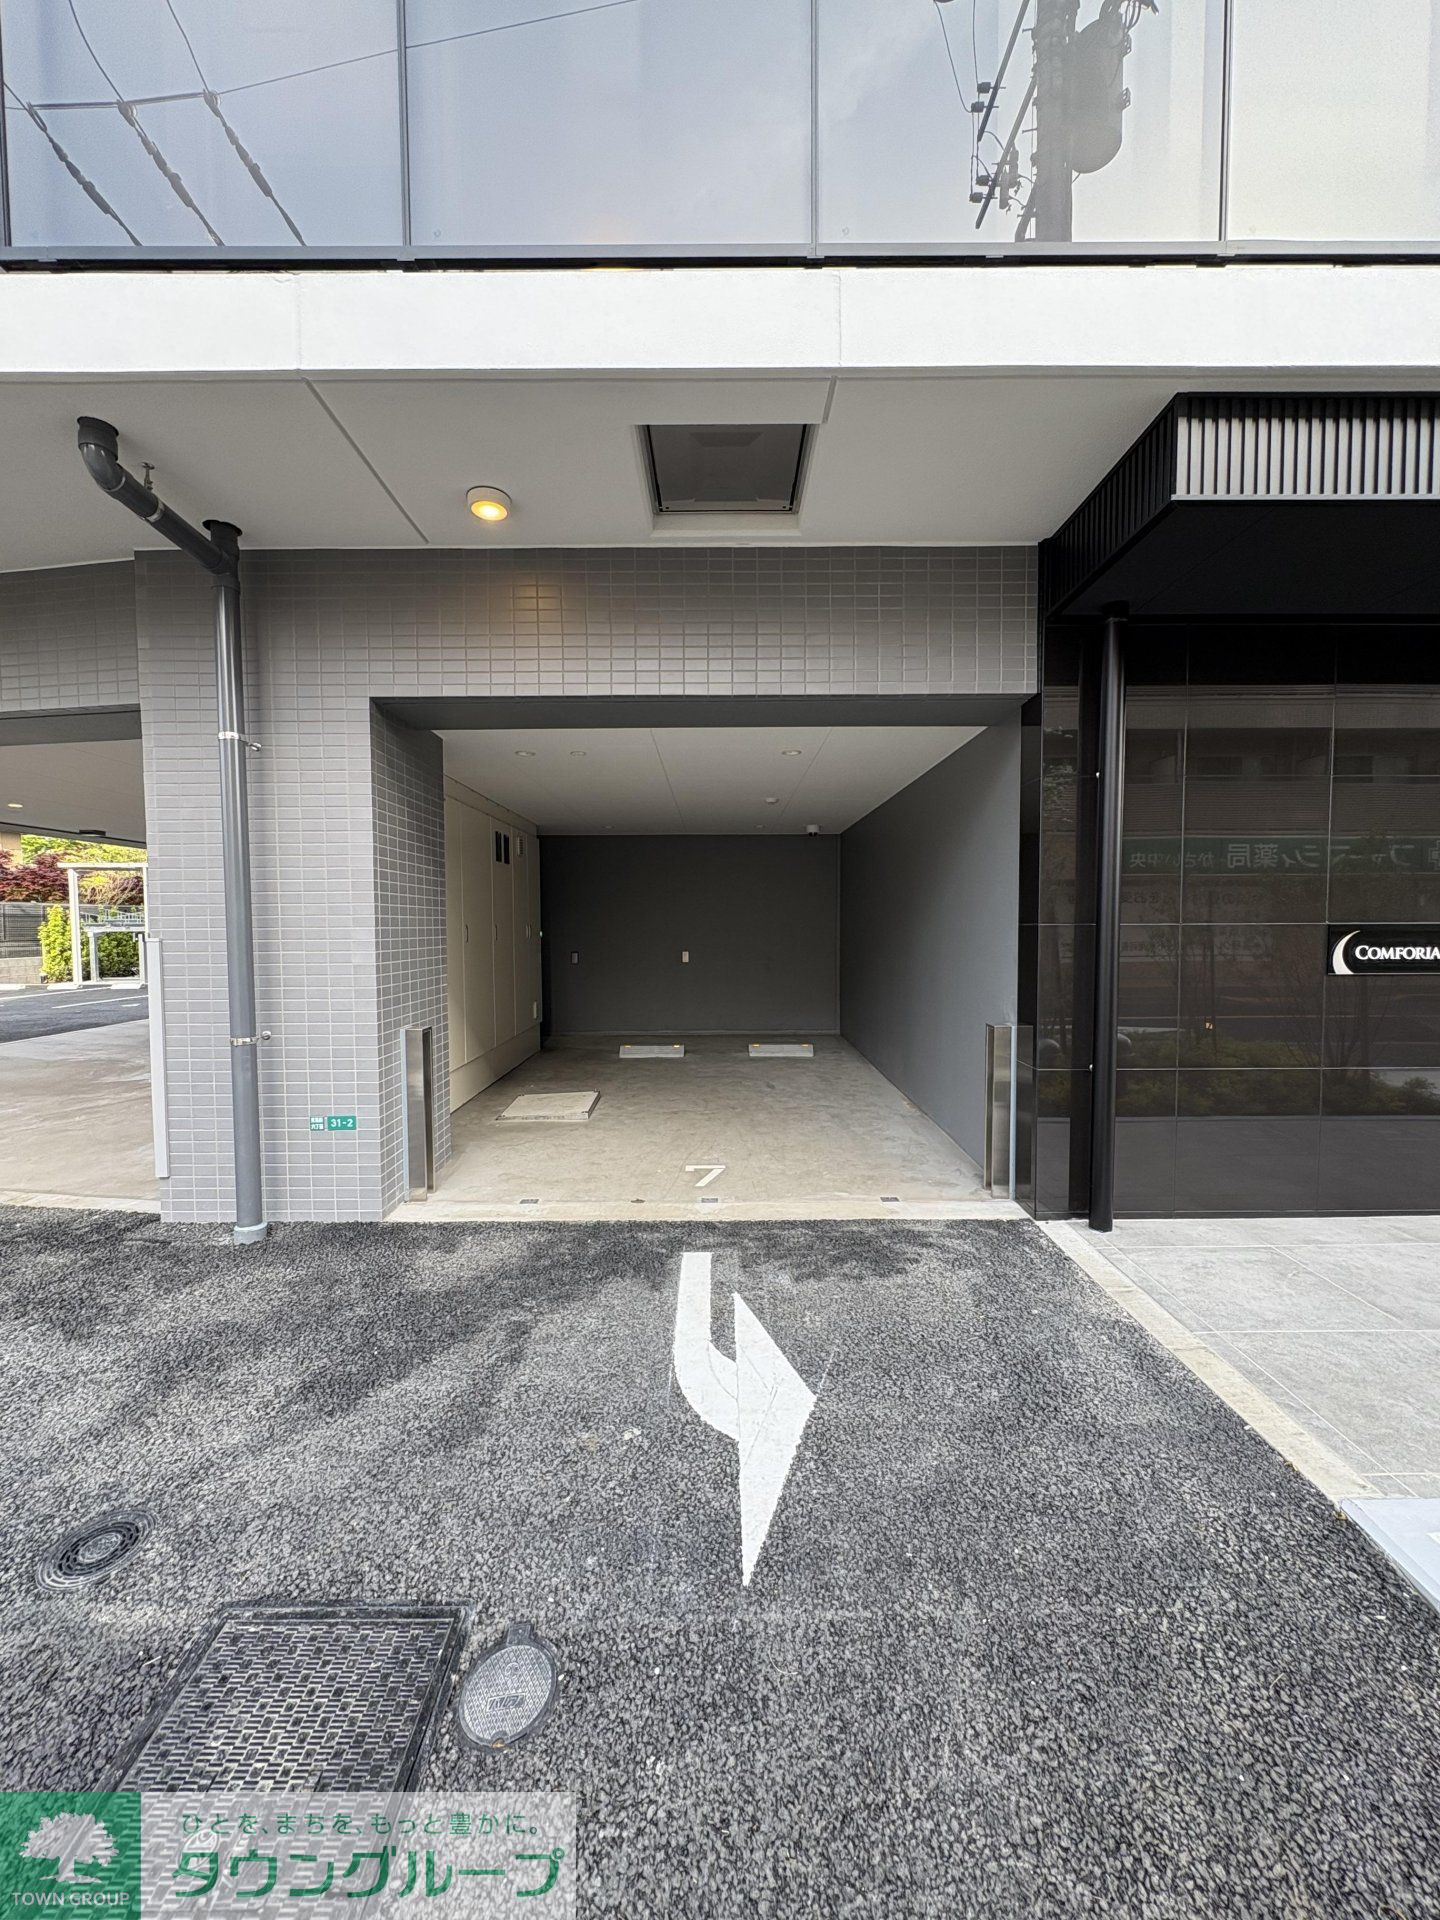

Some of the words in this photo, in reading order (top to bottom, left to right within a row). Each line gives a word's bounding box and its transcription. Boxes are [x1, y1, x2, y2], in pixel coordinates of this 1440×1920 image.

[1355, 945, 1440, 960] COMFORIA
[330, 1118, 353, 1128] 31-2
[685, 1164, 726, 1187] 7
